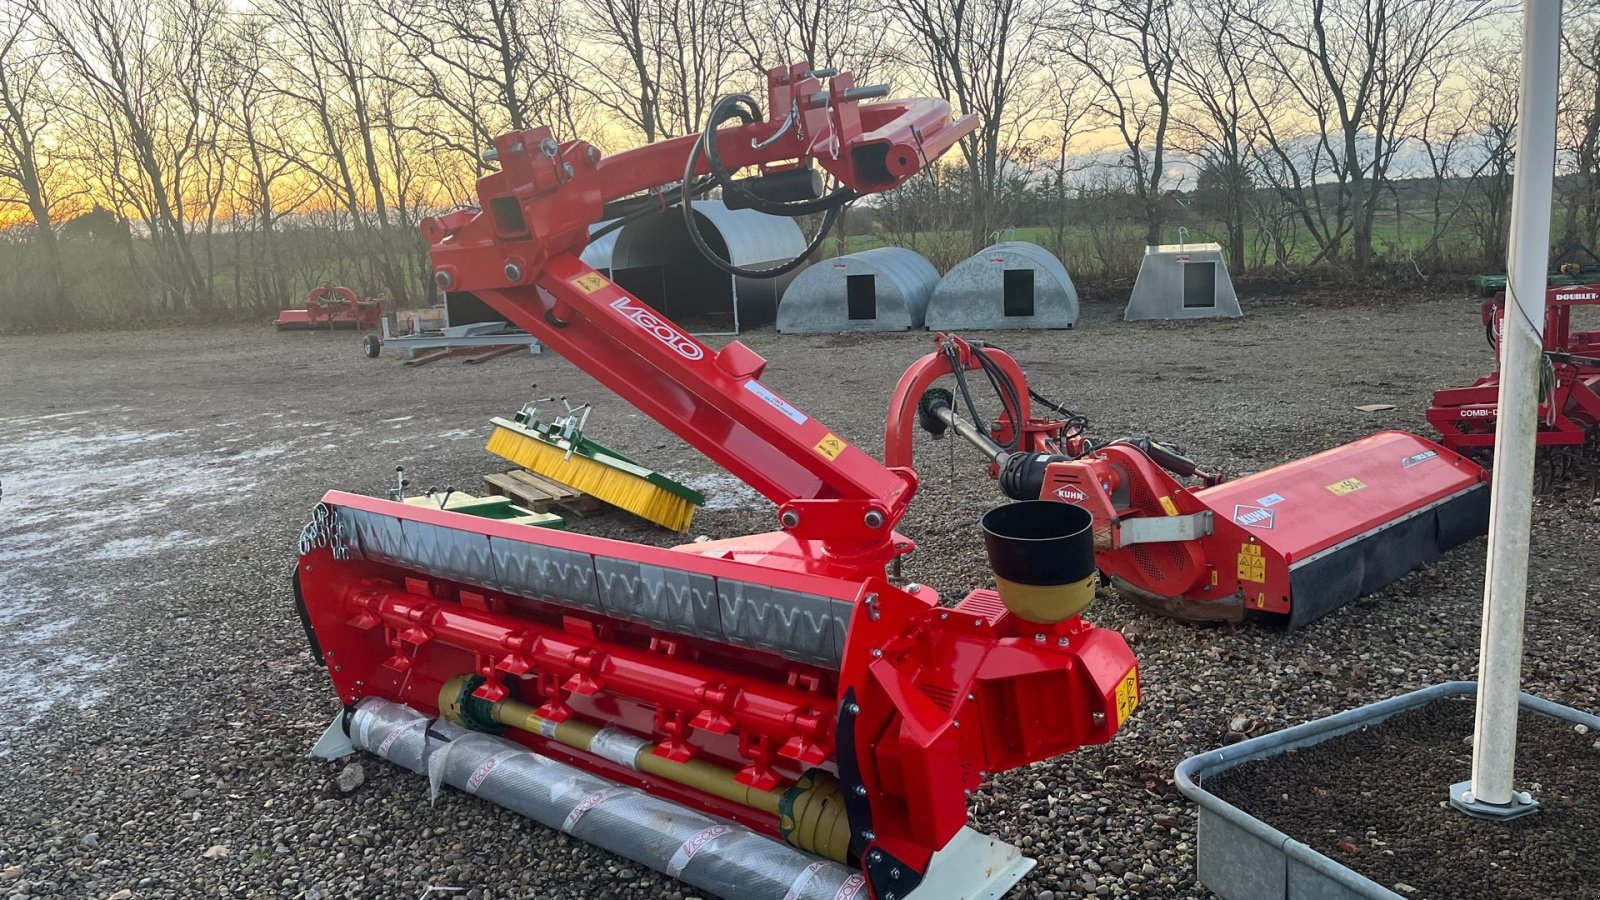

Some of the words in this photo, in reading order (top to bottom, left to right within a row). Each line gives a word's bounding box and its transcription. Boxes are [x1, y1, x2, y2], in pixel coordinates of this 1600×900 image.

[609, 296, 704, 361] VIGOLO
[1058, 489, 1083, 500] KUHN
[1235, 508, 1272, 526] KUHN
[682, 824, 727, 859] VIGOLO
